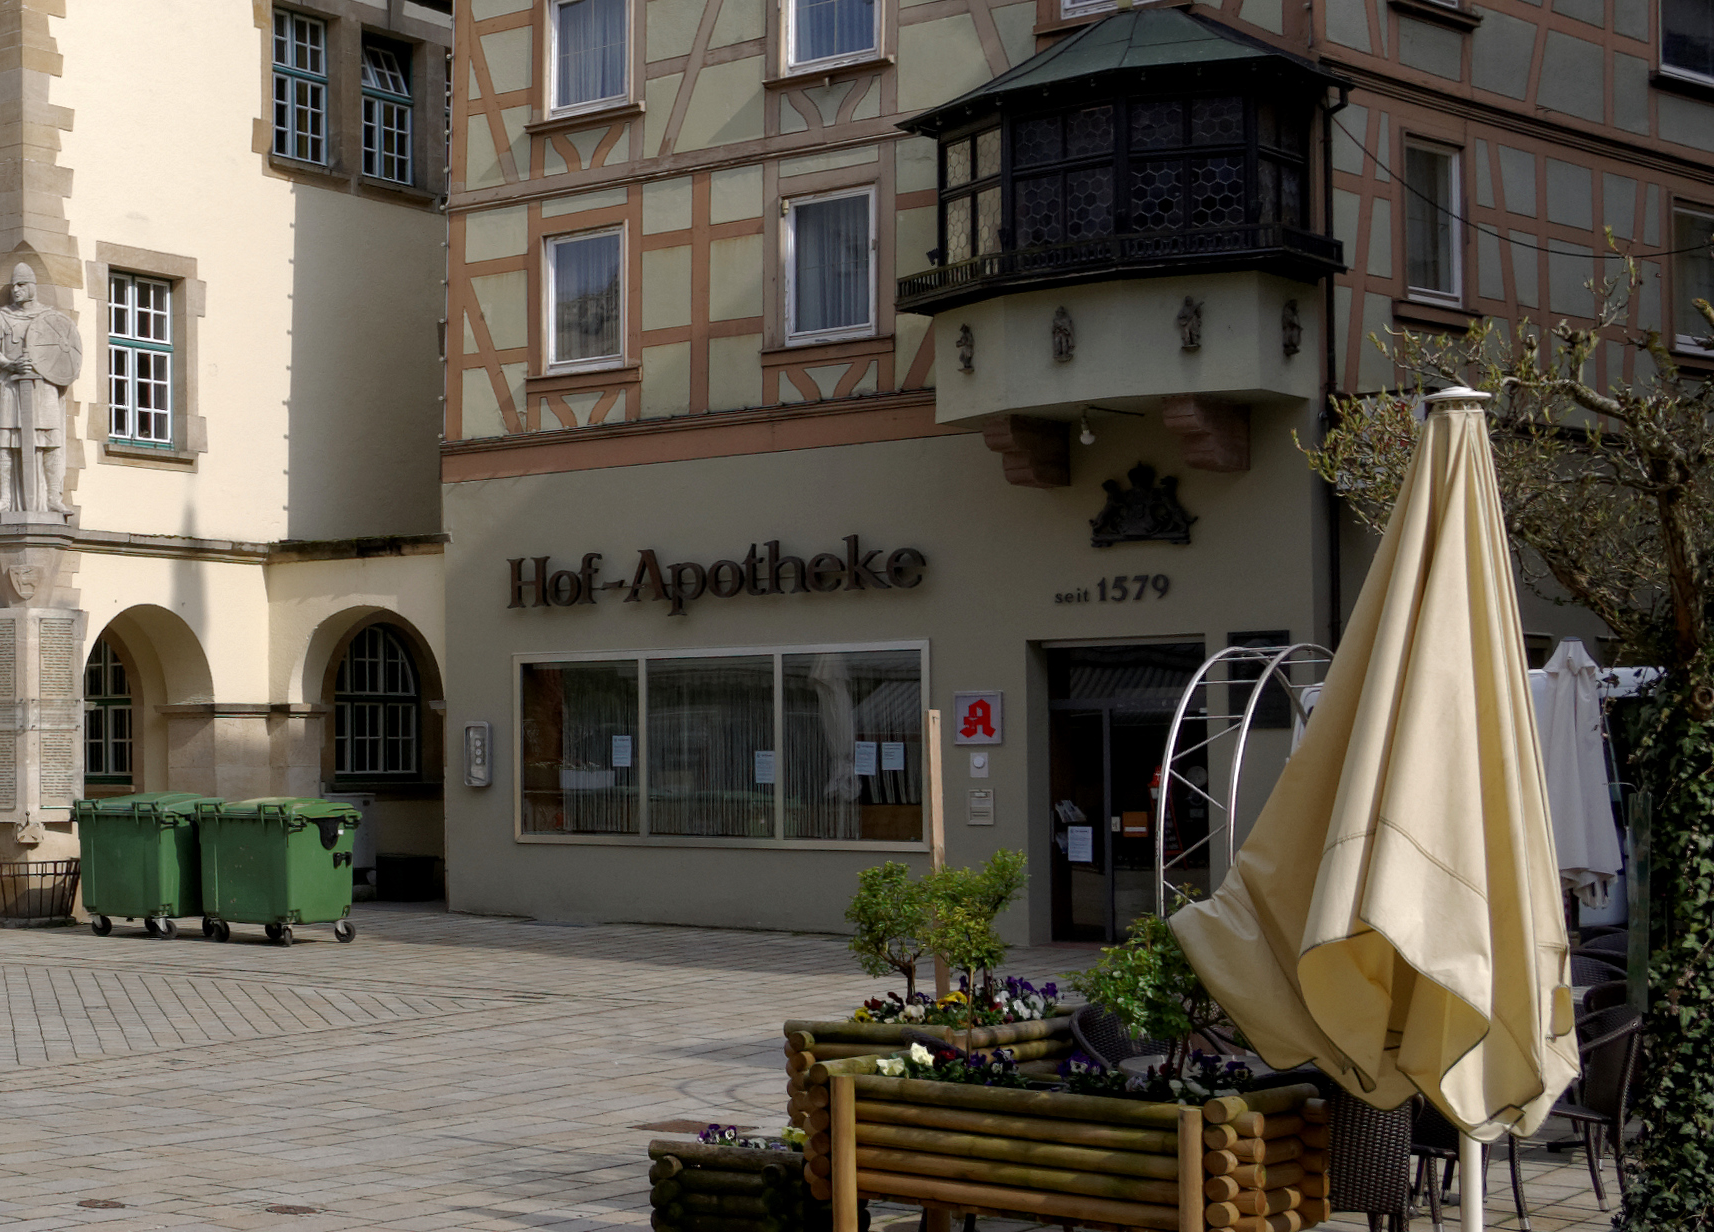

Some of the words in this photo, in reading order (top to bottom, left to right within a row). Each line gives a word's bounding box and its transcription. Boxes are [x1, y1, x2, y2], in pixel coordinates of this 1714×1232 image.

[506, 534, 927, 616] Hof-Apotheke
[1054, 587, 1091, 604] seit
[1096, 574, 1170, 602] 1579
